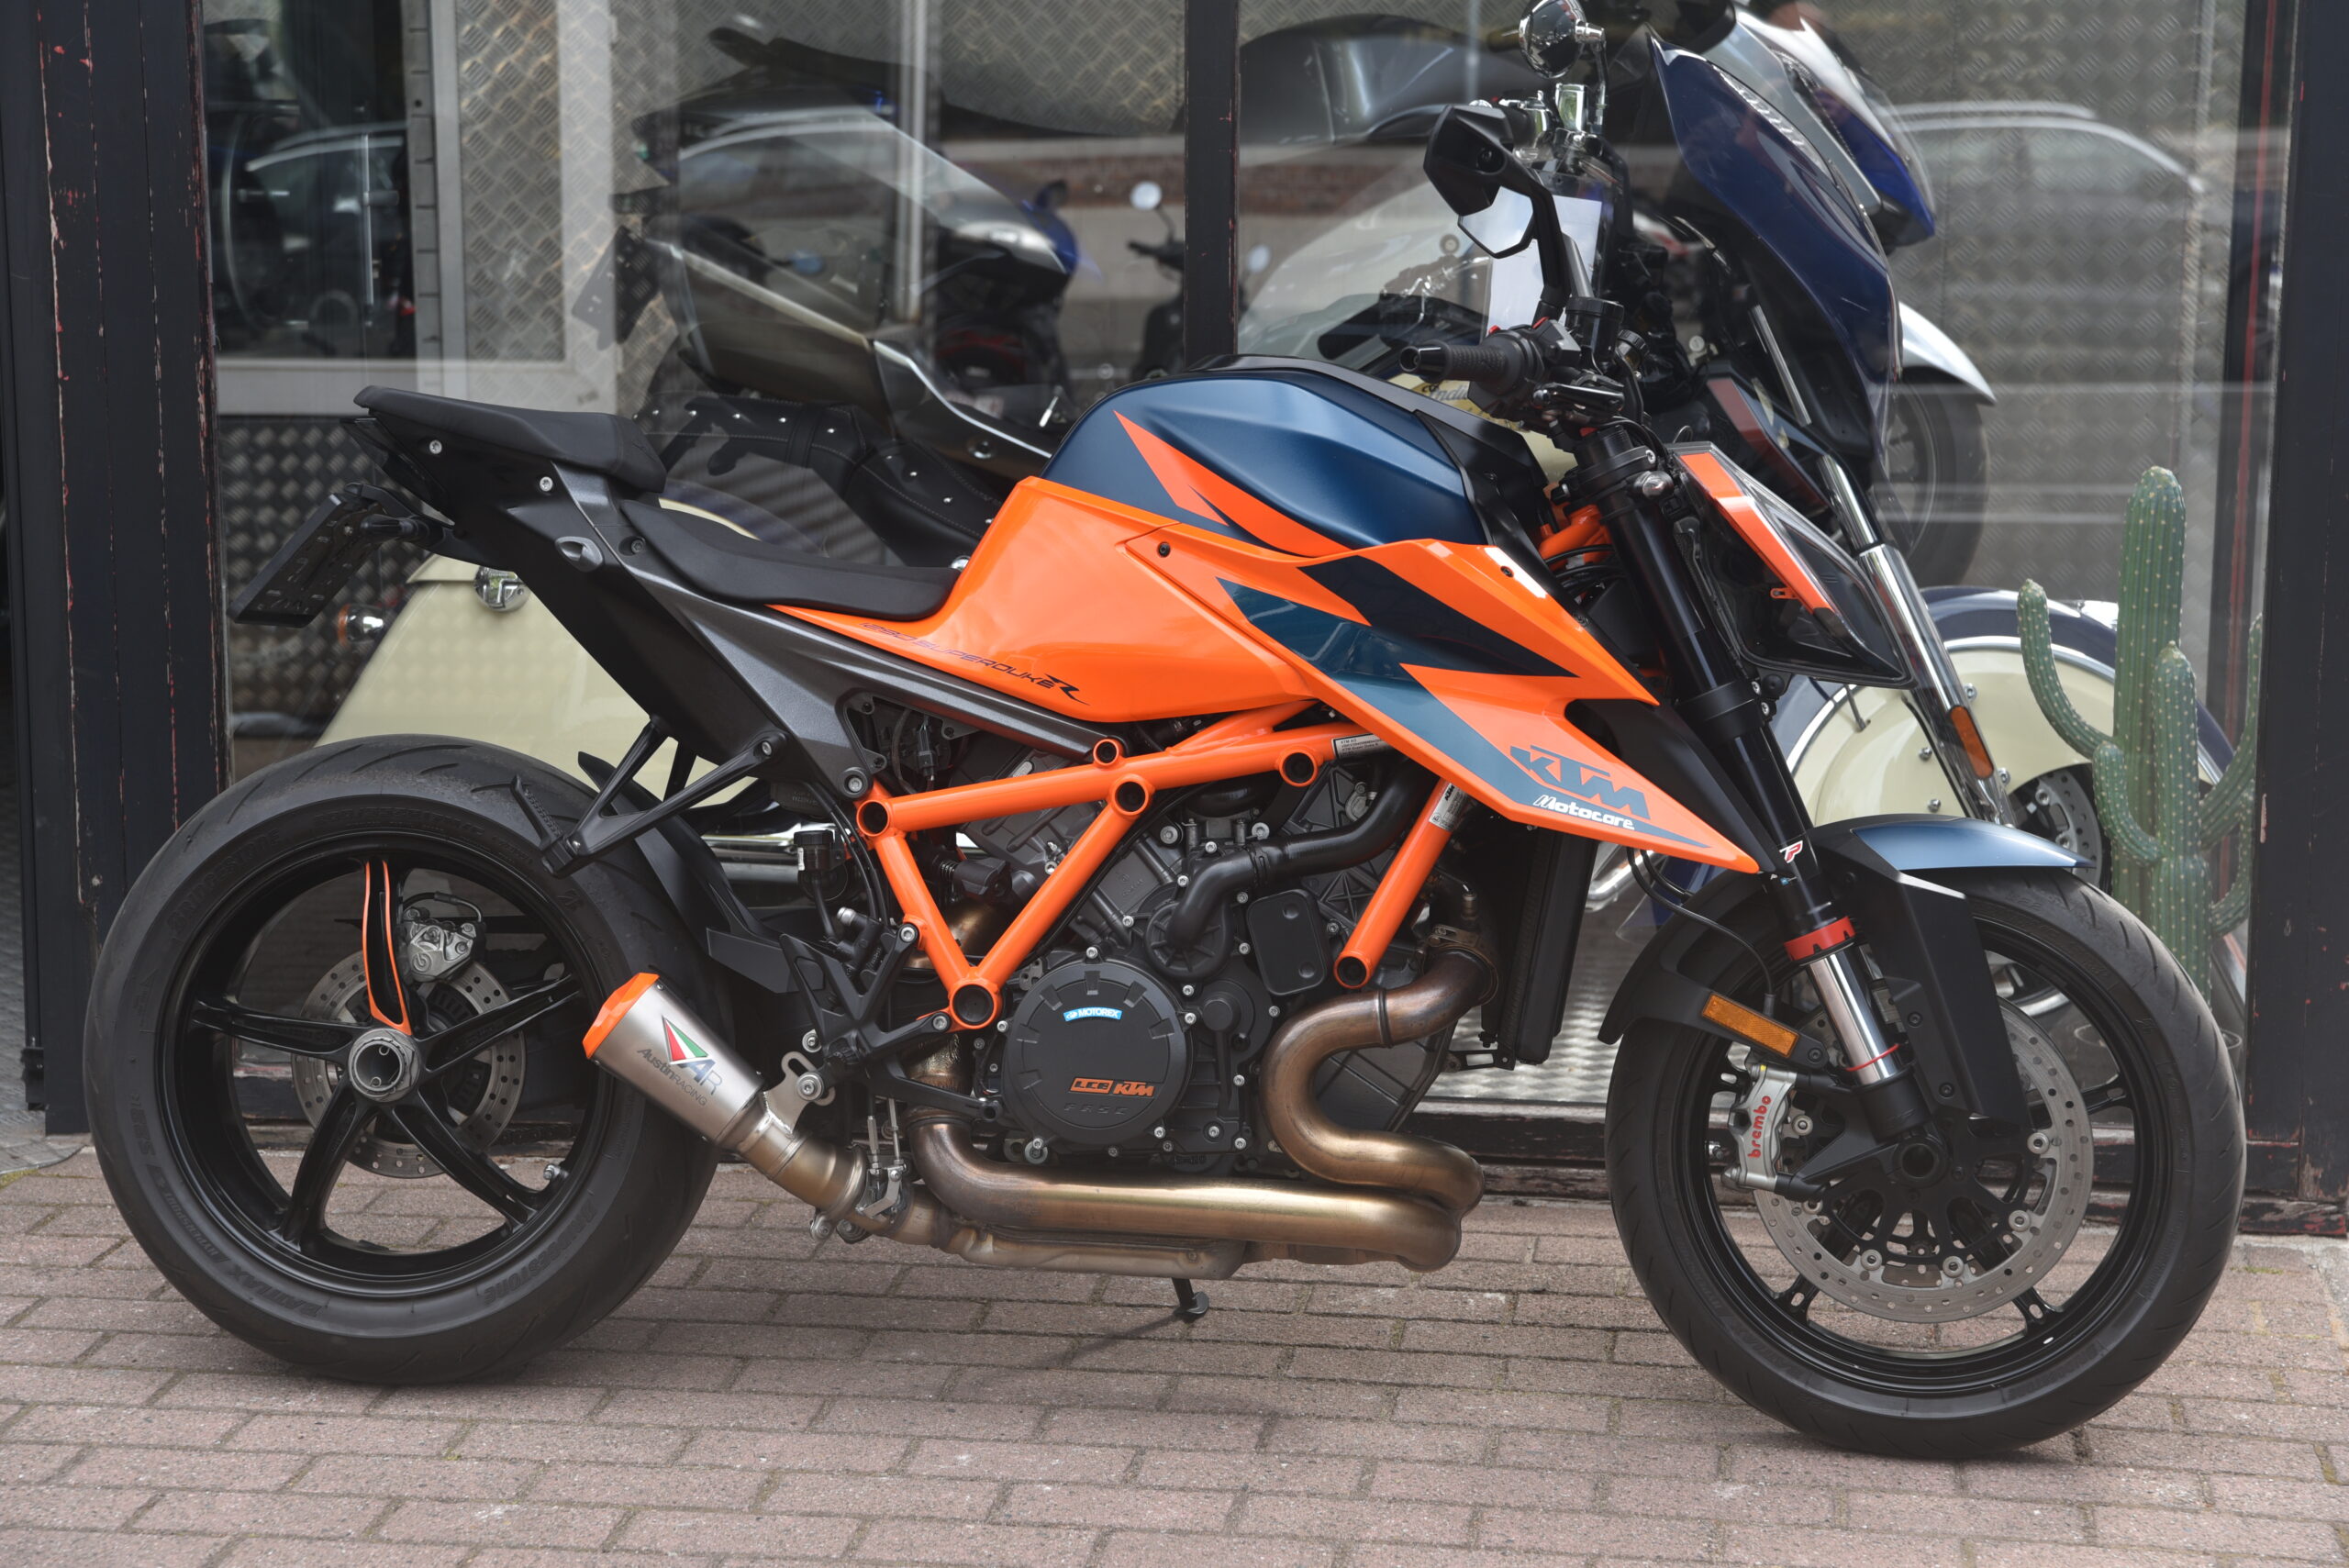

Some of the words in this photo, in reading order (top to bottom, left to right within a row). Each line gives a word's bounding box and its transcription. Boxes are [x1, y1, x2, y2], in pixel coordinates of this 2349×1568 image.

[1509, 744, 1651, 820] KTM
[1532, 795, 1635, 830] Motocare
[1078, 1006, 1119, 1019] MOTOREX
[1113, 1081, 1155, 1097] KTM
[1747, 1095, 1772, 1159] brembo
